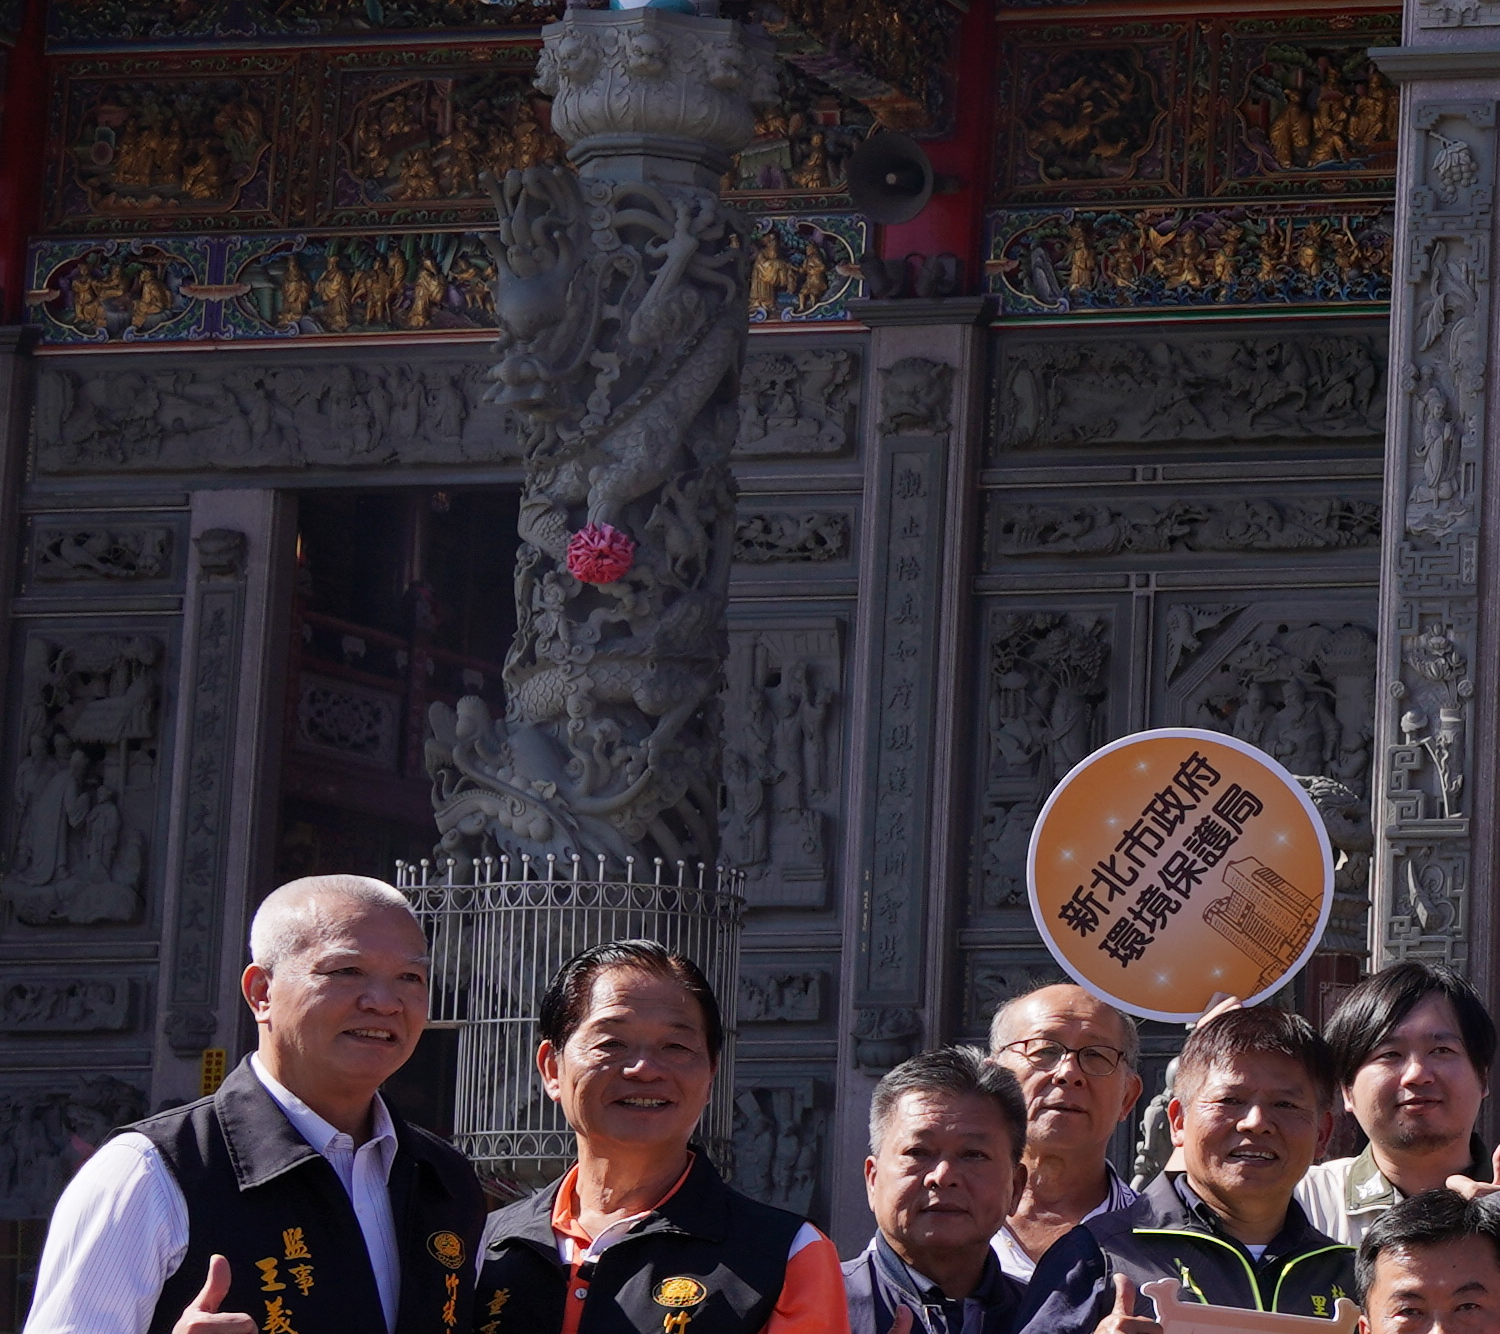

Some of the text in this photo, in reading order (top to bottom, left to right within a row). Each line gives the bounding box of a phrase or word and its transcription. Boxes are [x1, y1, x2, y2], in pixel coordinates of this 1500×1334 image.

[1058, 751, 1222, 937] 新北市政府
[1099, 784, 1263, 968] 環境保護局
[282, 1227, 315, 1296] 監事
